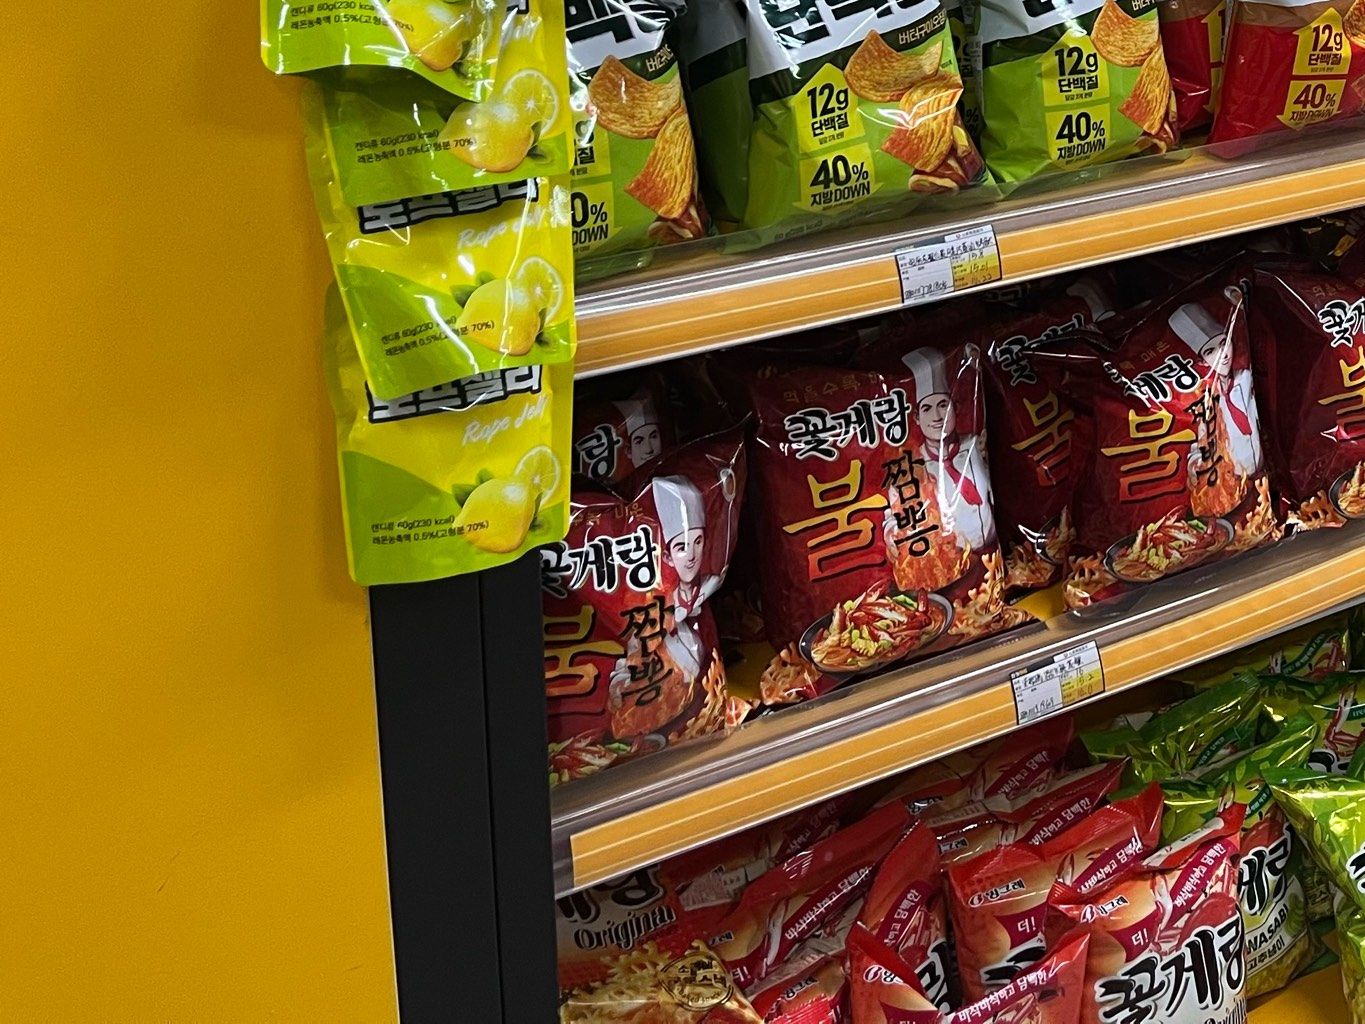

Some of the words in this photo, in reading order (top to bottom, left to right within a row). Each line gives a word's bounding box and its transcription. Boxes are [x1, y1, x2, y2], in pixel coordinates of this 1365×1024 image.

[1311, 23, 1343, 53] 12g
[1054, 45, 1099, 77] 12g
[1307, 50, 1343, 67] 단백질
[1057, 75, 1099, 93] 단백질
[1292, 81, 1337, 108] 40%
[806, 81, 850, 119] 12g
[811, 114, 850, 137] 단백질
[1055, 111, 1106, 144] 40%
[809, 154, 870, 188] 40%
[782, 389, 912, 461] 꽃게랑
[1101, 408, 1199, 505] 불
[466, 520, 490, 533] 70%)
[782, 458, 891, 583] 불
[1199, 842, 1225, 866] 담백한
[573, 904, 678, 951] Original
[1017, 915, 1036, 933] 더!
[1131, 927, 1149, 947] 더!
